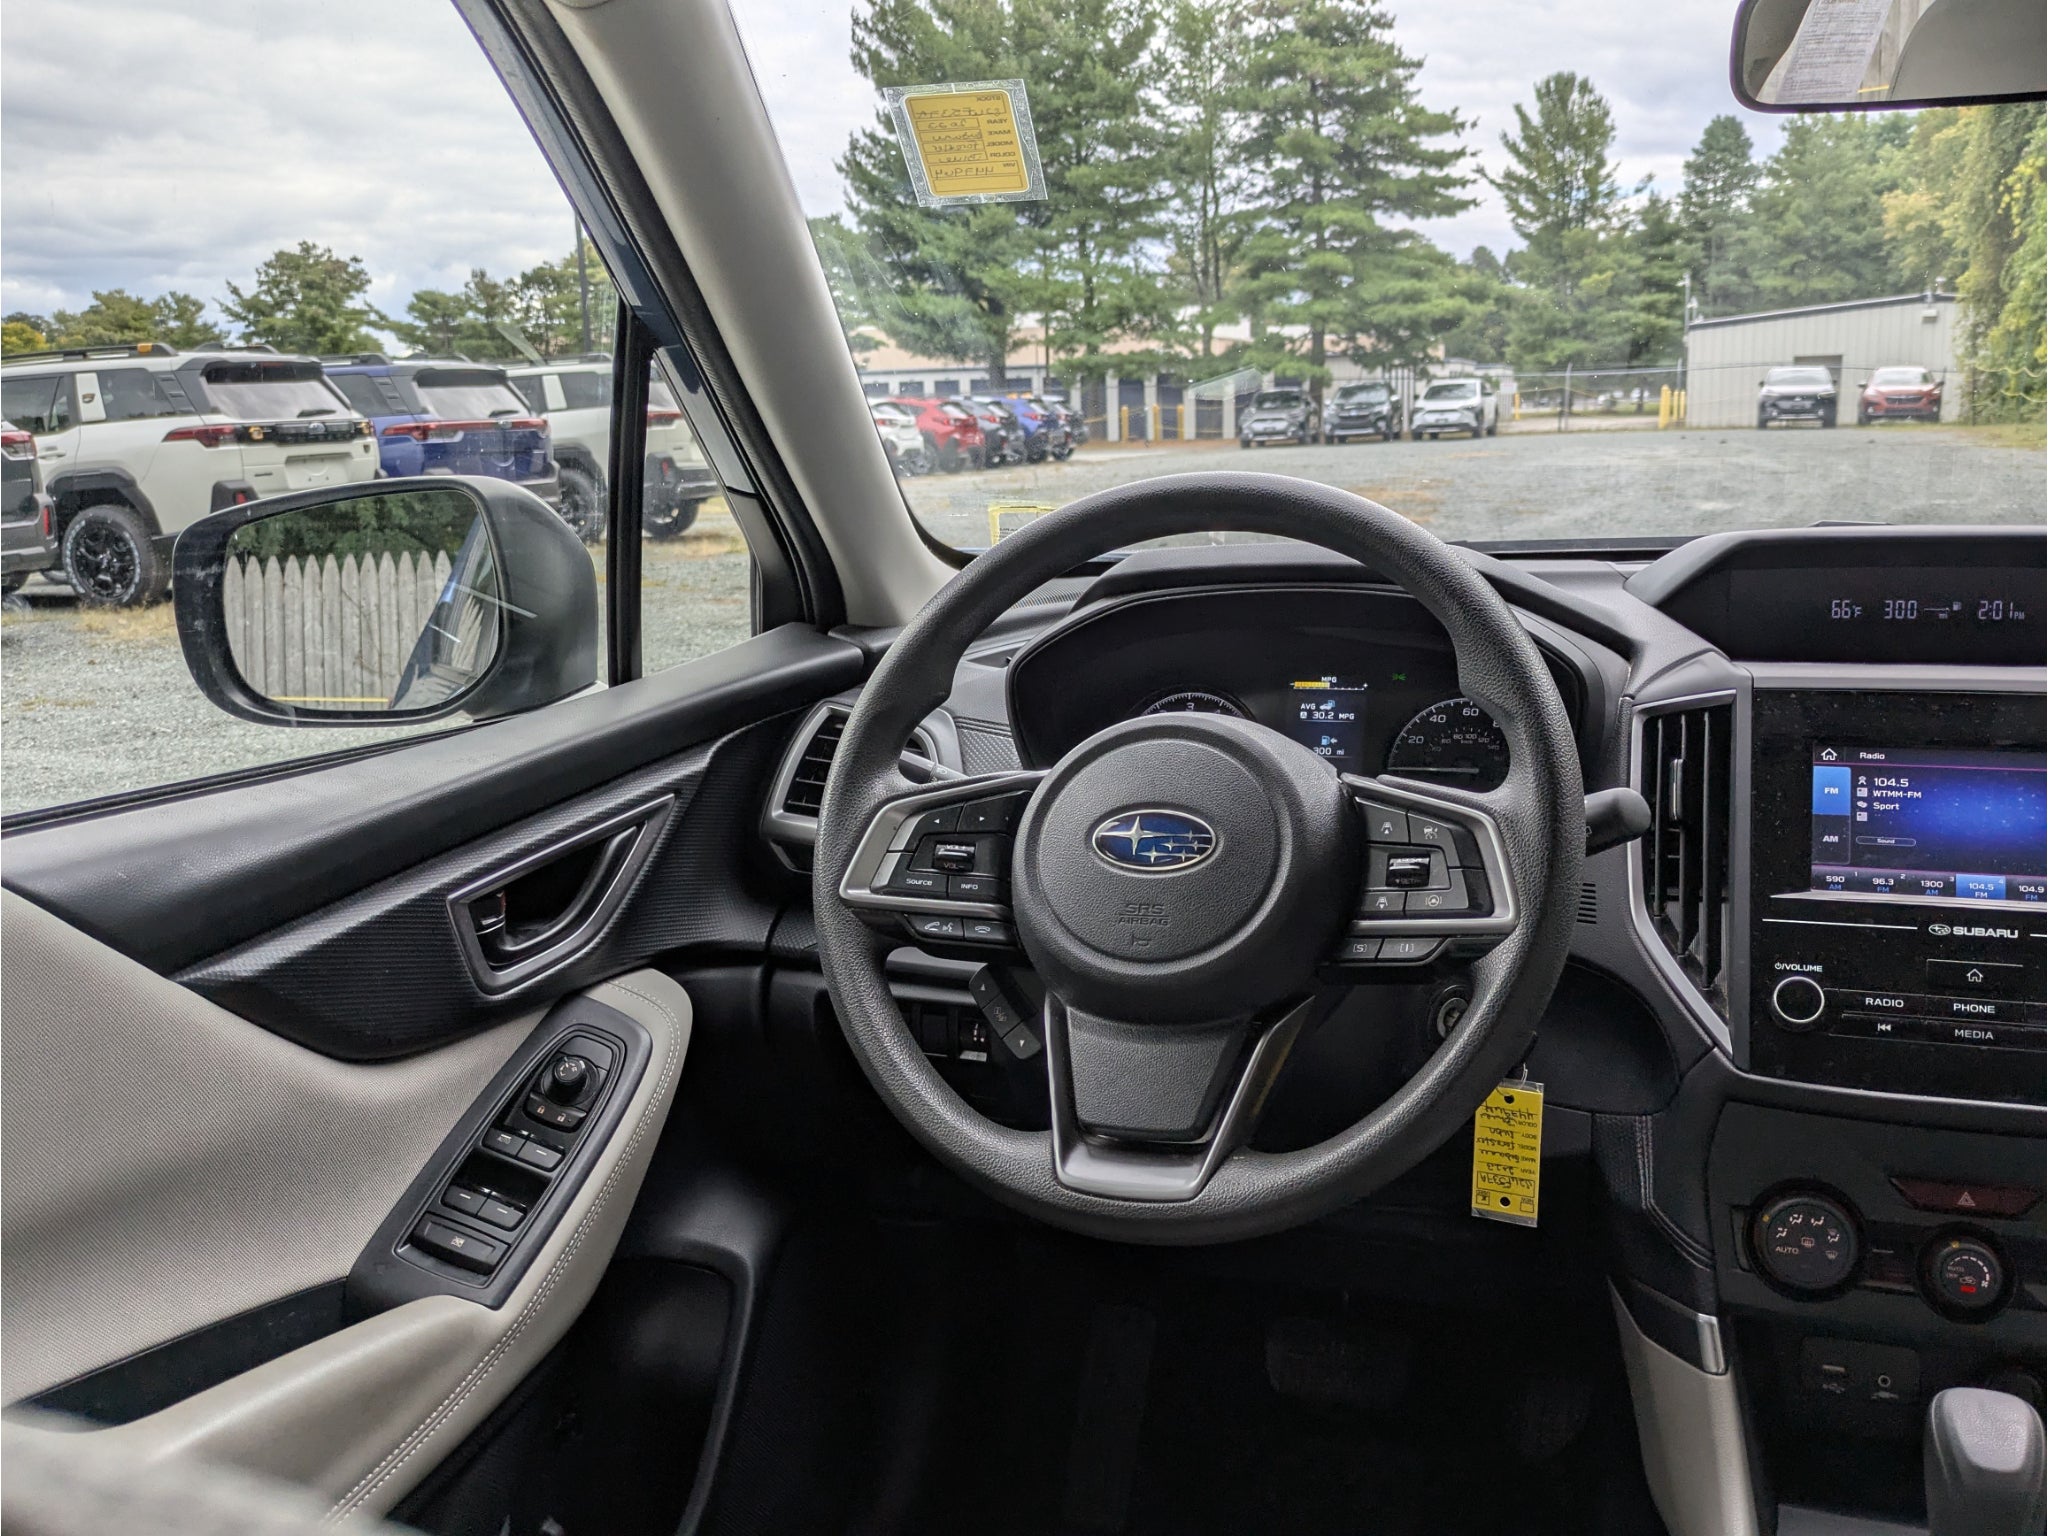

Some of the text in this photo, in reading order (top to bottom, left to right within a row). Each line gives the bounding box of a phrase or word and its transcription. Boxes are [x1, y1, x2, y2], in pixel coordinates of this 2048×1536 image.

[1883, 600, 1918, 619] 300
[1312, 711, 1335, 720] 30.2
[1462, 707, 1479, 716] 60
[1429, 714, 1447, 723] 40
[1407, 735, 1425, 744] 20
[1859, 752, 1885, 760] Radio
[1873, 777, 1909, 788] 104.5
[1824, 787, 1839, 795] FM
[1872, 790, 1922, 799] WTMM-FM
[1873, 801, 1900, 811] Sport
[1822, 834, 1839, 843] AM
[906, 877, 933, 886] Source
[1826, 875, 1845, 883] 590
[1872, 877, 1895, 886] 96.3
[1920, 880, 1944, 888] 1300
[1968, 882, 1994, 891] 104.5
[2018, 885, 2045, 894] 104.9
[1975, 891, 1988, 899] FM
[1952, 926, 2019, 939] SUBARU
[1865, 997, 1904, 1009] RADIO
[1953, 1003, 1996, 1014] PHONE
[1954, 1028, 1994, 1040] MEDIA
[1775, 1245, 1799, 1255] AUTO
